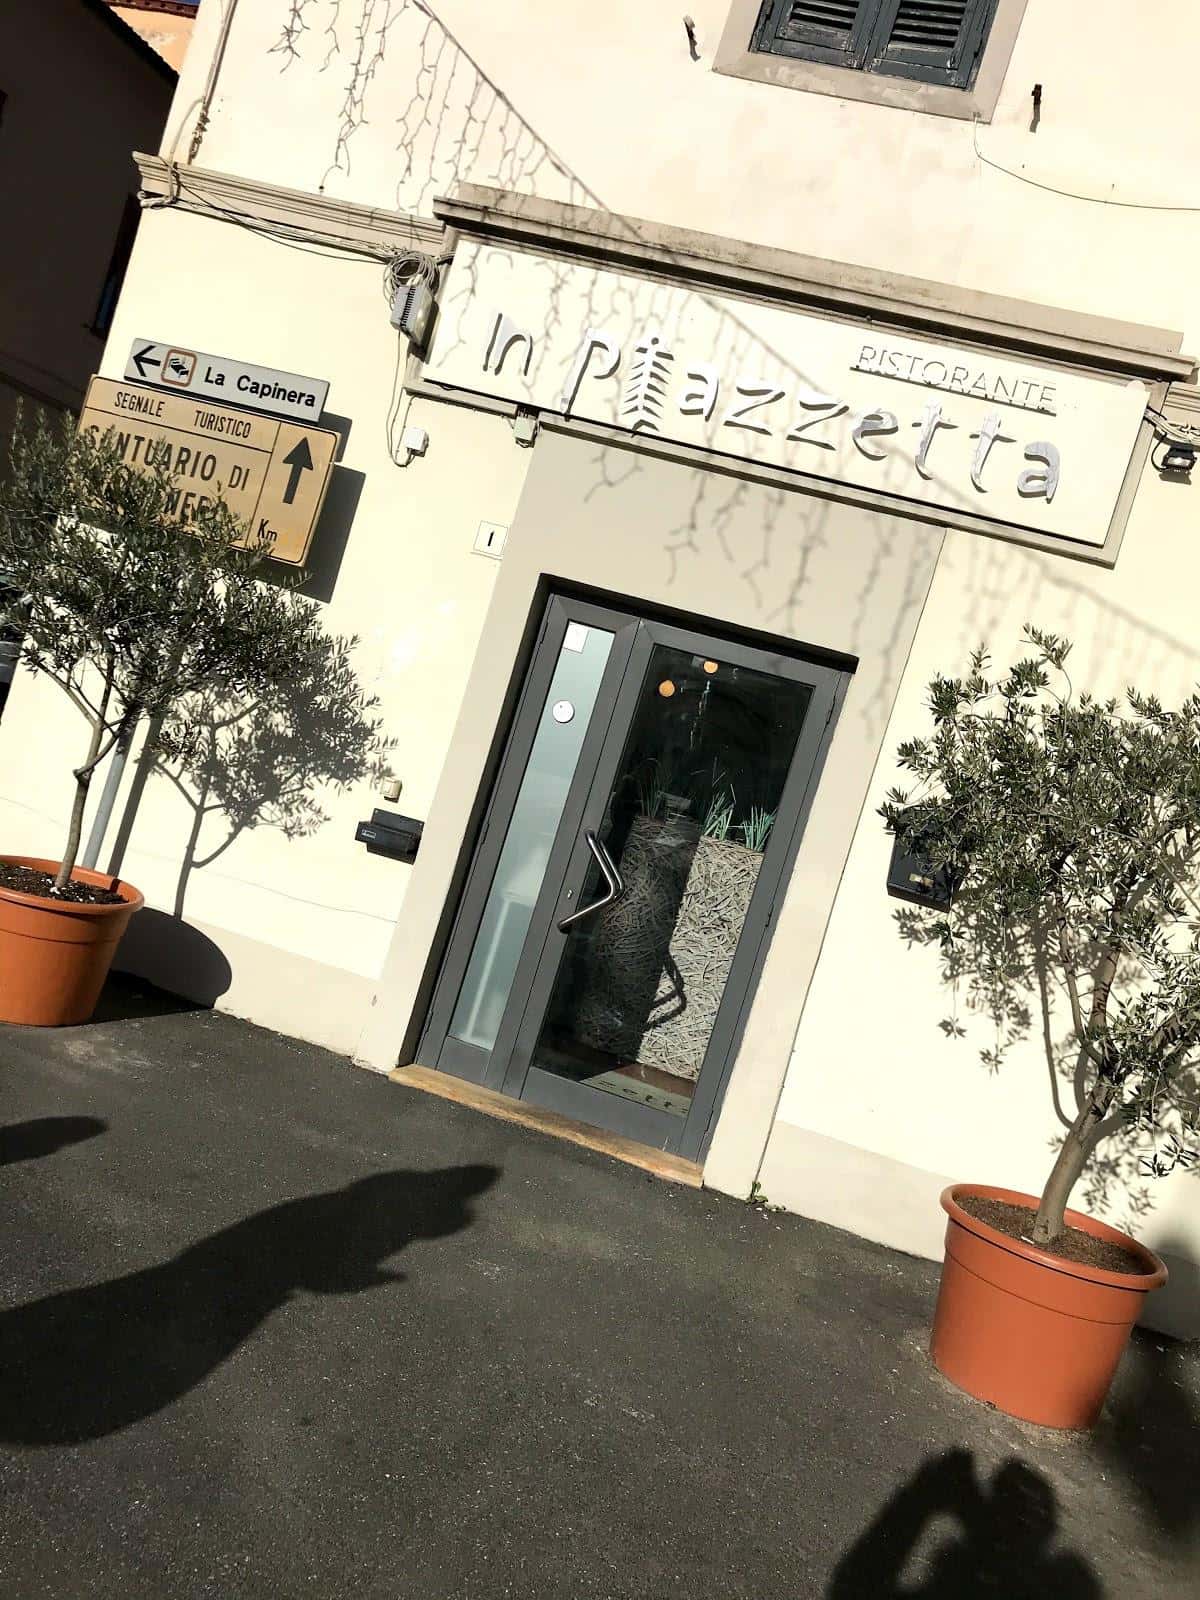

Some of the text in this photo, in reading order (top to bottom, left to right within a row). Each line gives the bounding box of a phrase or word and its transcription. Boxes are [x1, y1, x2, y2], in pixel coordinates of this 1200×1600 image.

[482, 312, 534, 377] In
[204, 367, 316, 408] La Capinera
[858, 345, 1057, 413] RISTORANTE
[114, 391, 252, 439] SEGNALE TURISTICO
[228, 465, 251, 491] DI
[257, 519, 278, 543] Km
